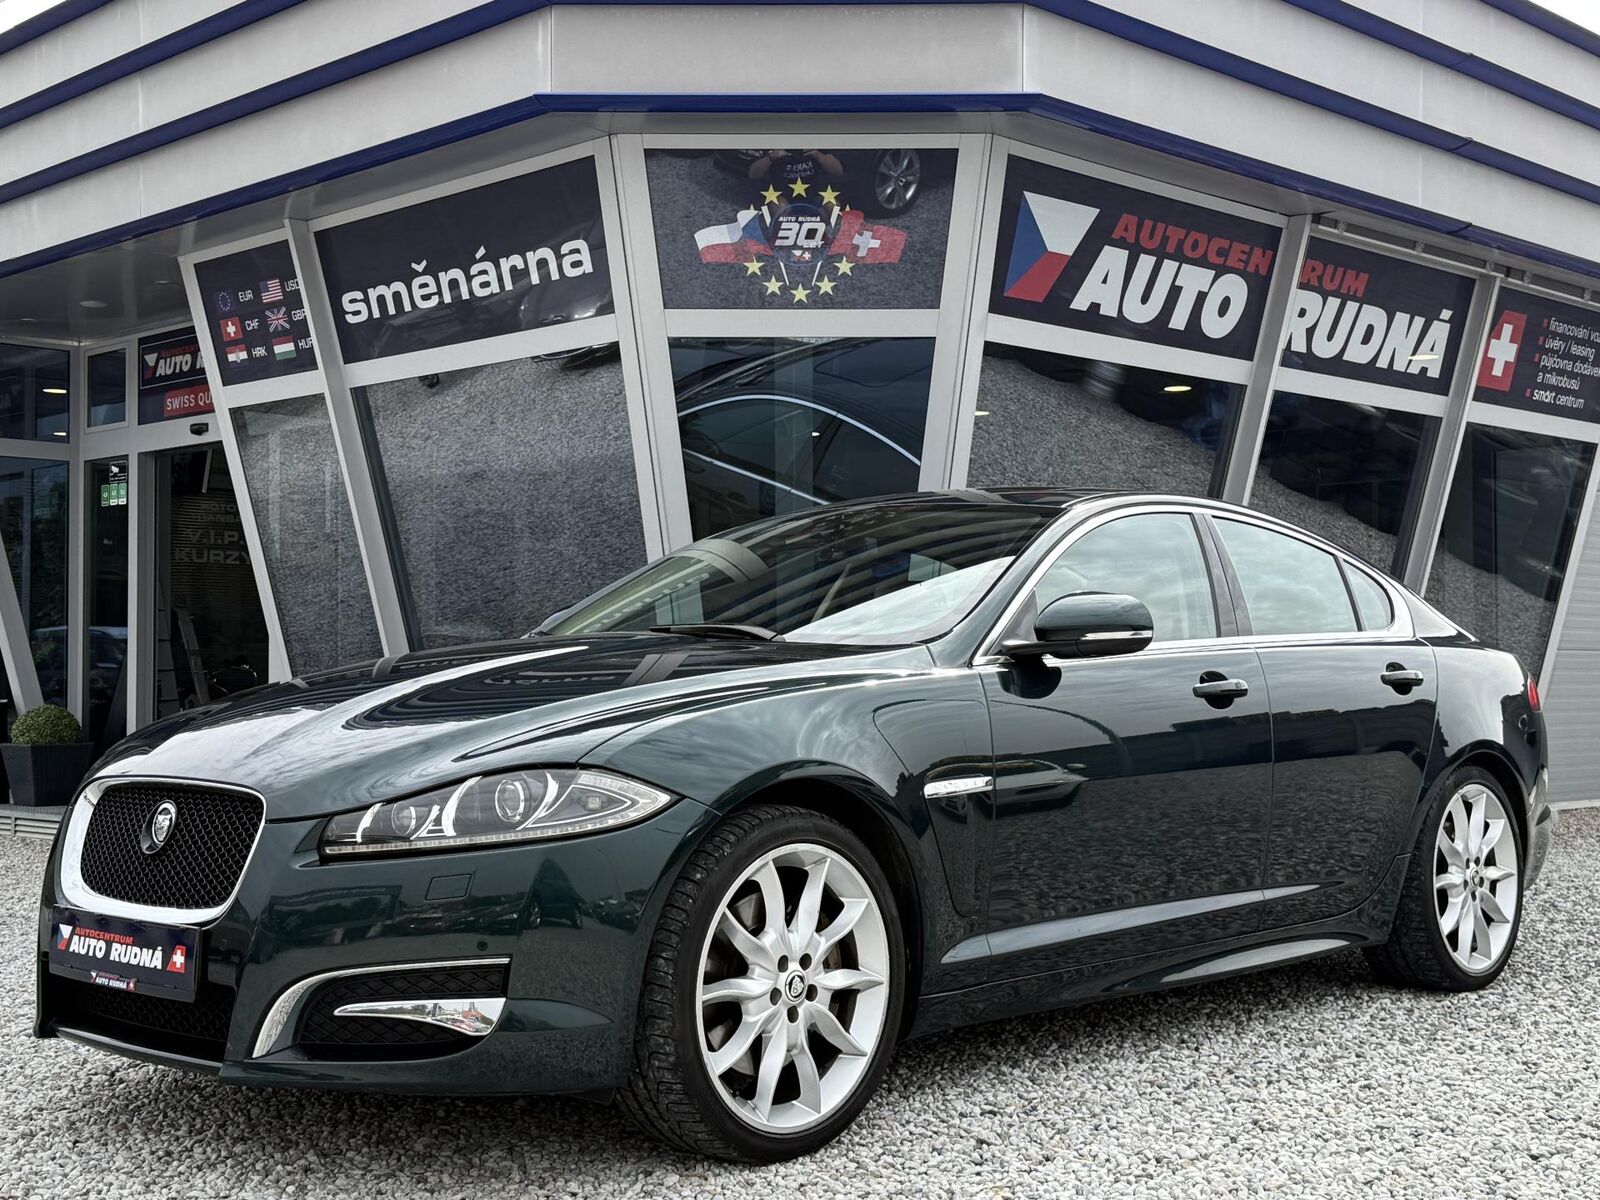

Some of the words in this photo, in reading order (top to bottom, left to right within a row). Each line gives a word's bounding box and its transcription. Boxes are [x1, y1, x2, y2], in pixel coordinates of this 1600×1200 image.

[774, 222, 826, 246] 30
[284, 278, 300, 292] USD
[341, 238, 594, 324] směnárna
[238, 290, 254, 302] EUR
[1069, 244, 1249, 339] AUTO
[1282, 288, 1454, 379] RUDNÁ
[245, 318, 260, 331] CHF
[251, 346, 268, 358] HRK
[1570, 341, 1595, 362] leasing
[155, 353, 192, 377] AUTO
[1537, 372, 1543, 383] a
[166, 394, 195, 410] SWISS
[1556, 394, 1585, 409] centrum
[74, 926, 134, 945] AUTOCENTRUM
[69, 936, 106, 959] AUTO
[109, 942, 163, 970] RUDNÁ
[95, 976, 109, 986] AUTO
